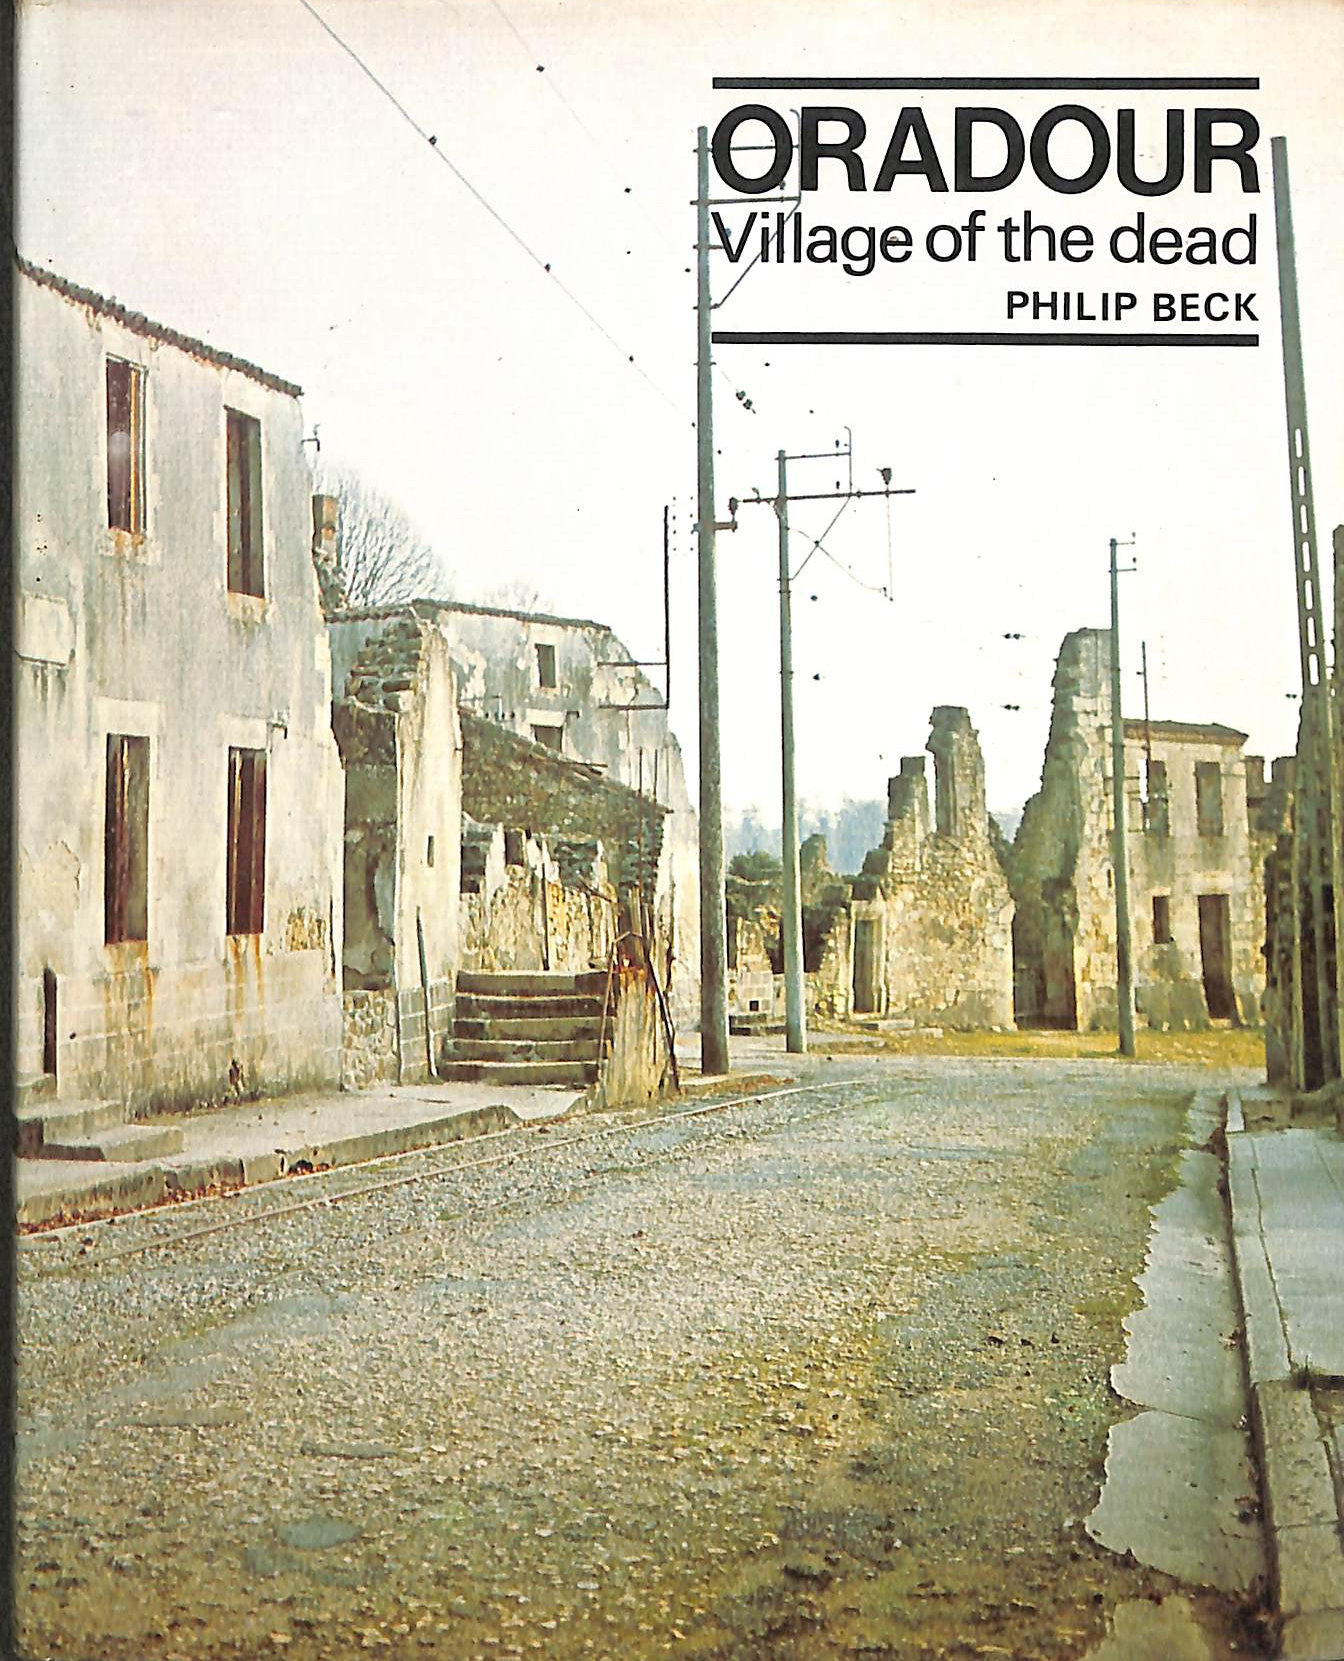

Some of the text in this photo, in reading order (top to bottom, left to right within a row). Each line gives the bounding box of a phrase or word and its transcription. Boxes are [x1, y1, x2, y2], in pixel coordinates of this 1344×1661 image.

[710, 104, 1261, 197] ORADOUR
[711, 209, 1257, 277] Village of the dead
[1007, 290, 1259, 322] PHILIP BECK
